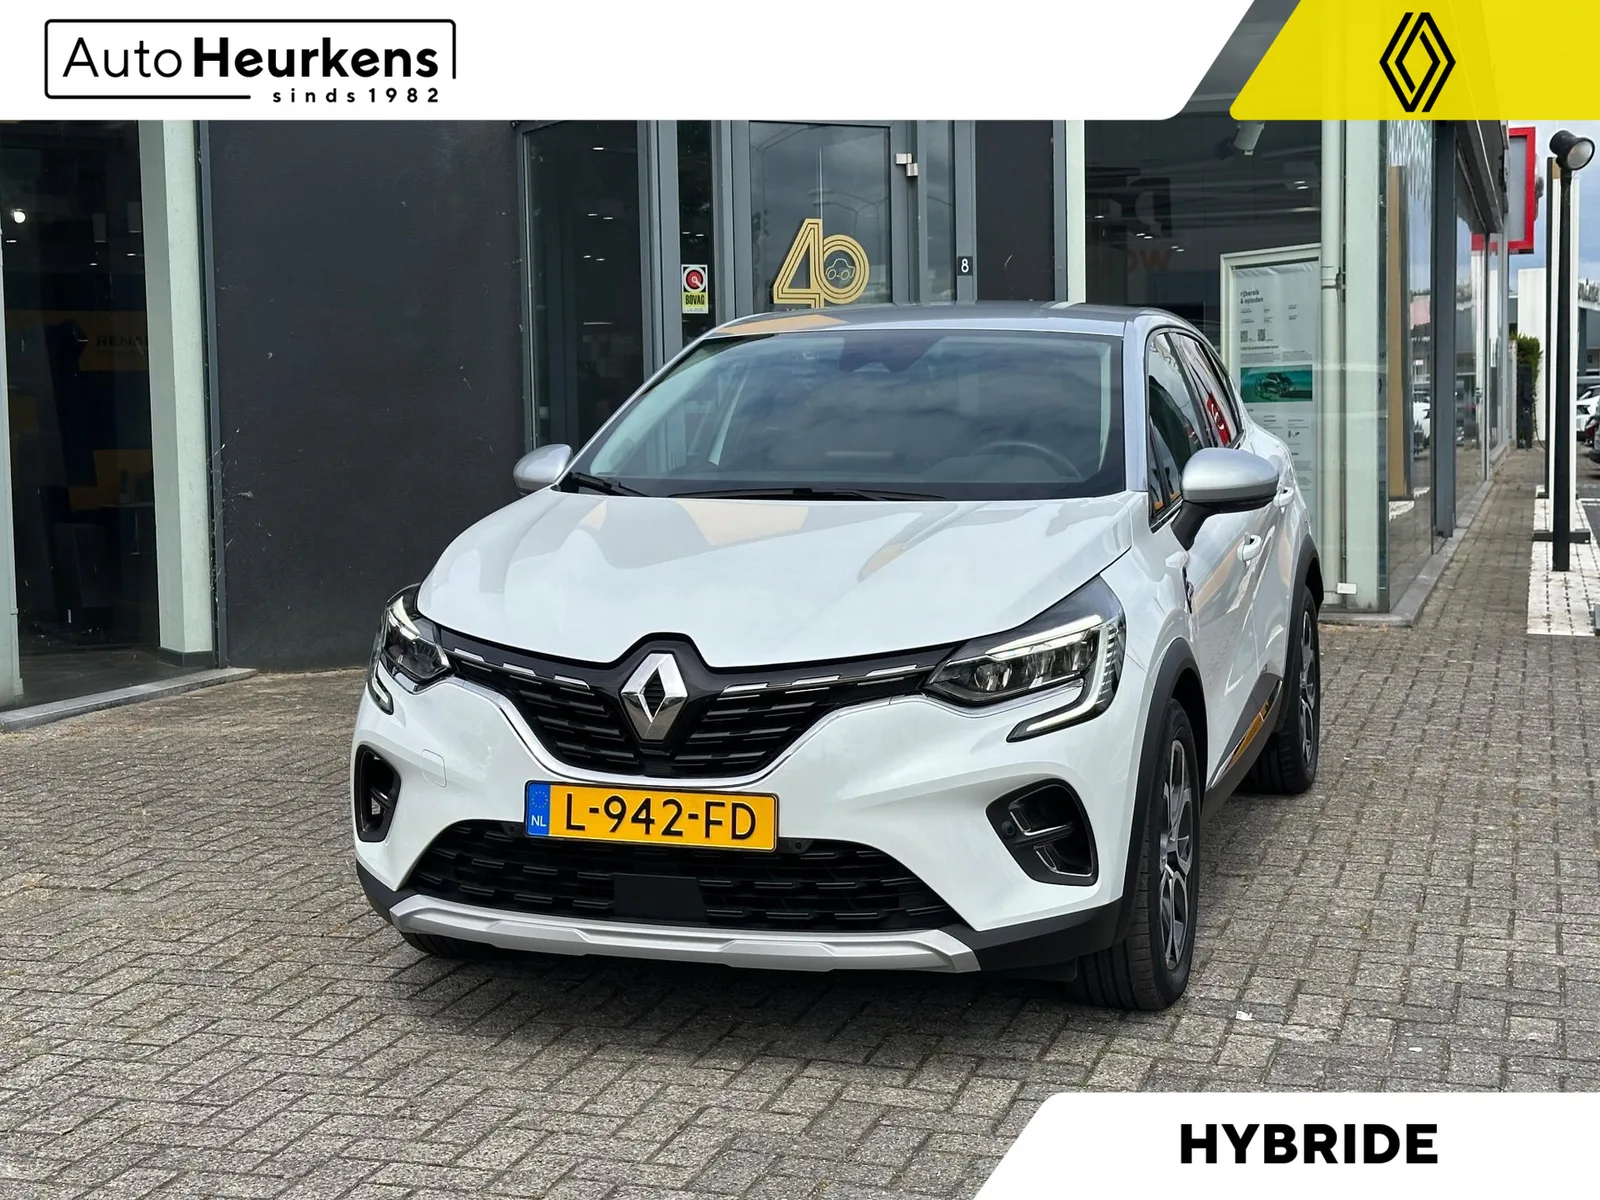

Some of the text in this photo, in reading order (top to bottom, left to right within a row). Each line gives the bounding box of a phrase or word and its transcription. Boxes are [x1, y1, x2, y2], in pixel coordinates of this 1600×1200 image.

[773, 218, 870, 309] 40
[960, 258, 969, 273] 8
[685, 294, 705, 305] BOVAG
[530, 815, 547, 827] NL
[565, 793, 757, 841] L-942-FD
